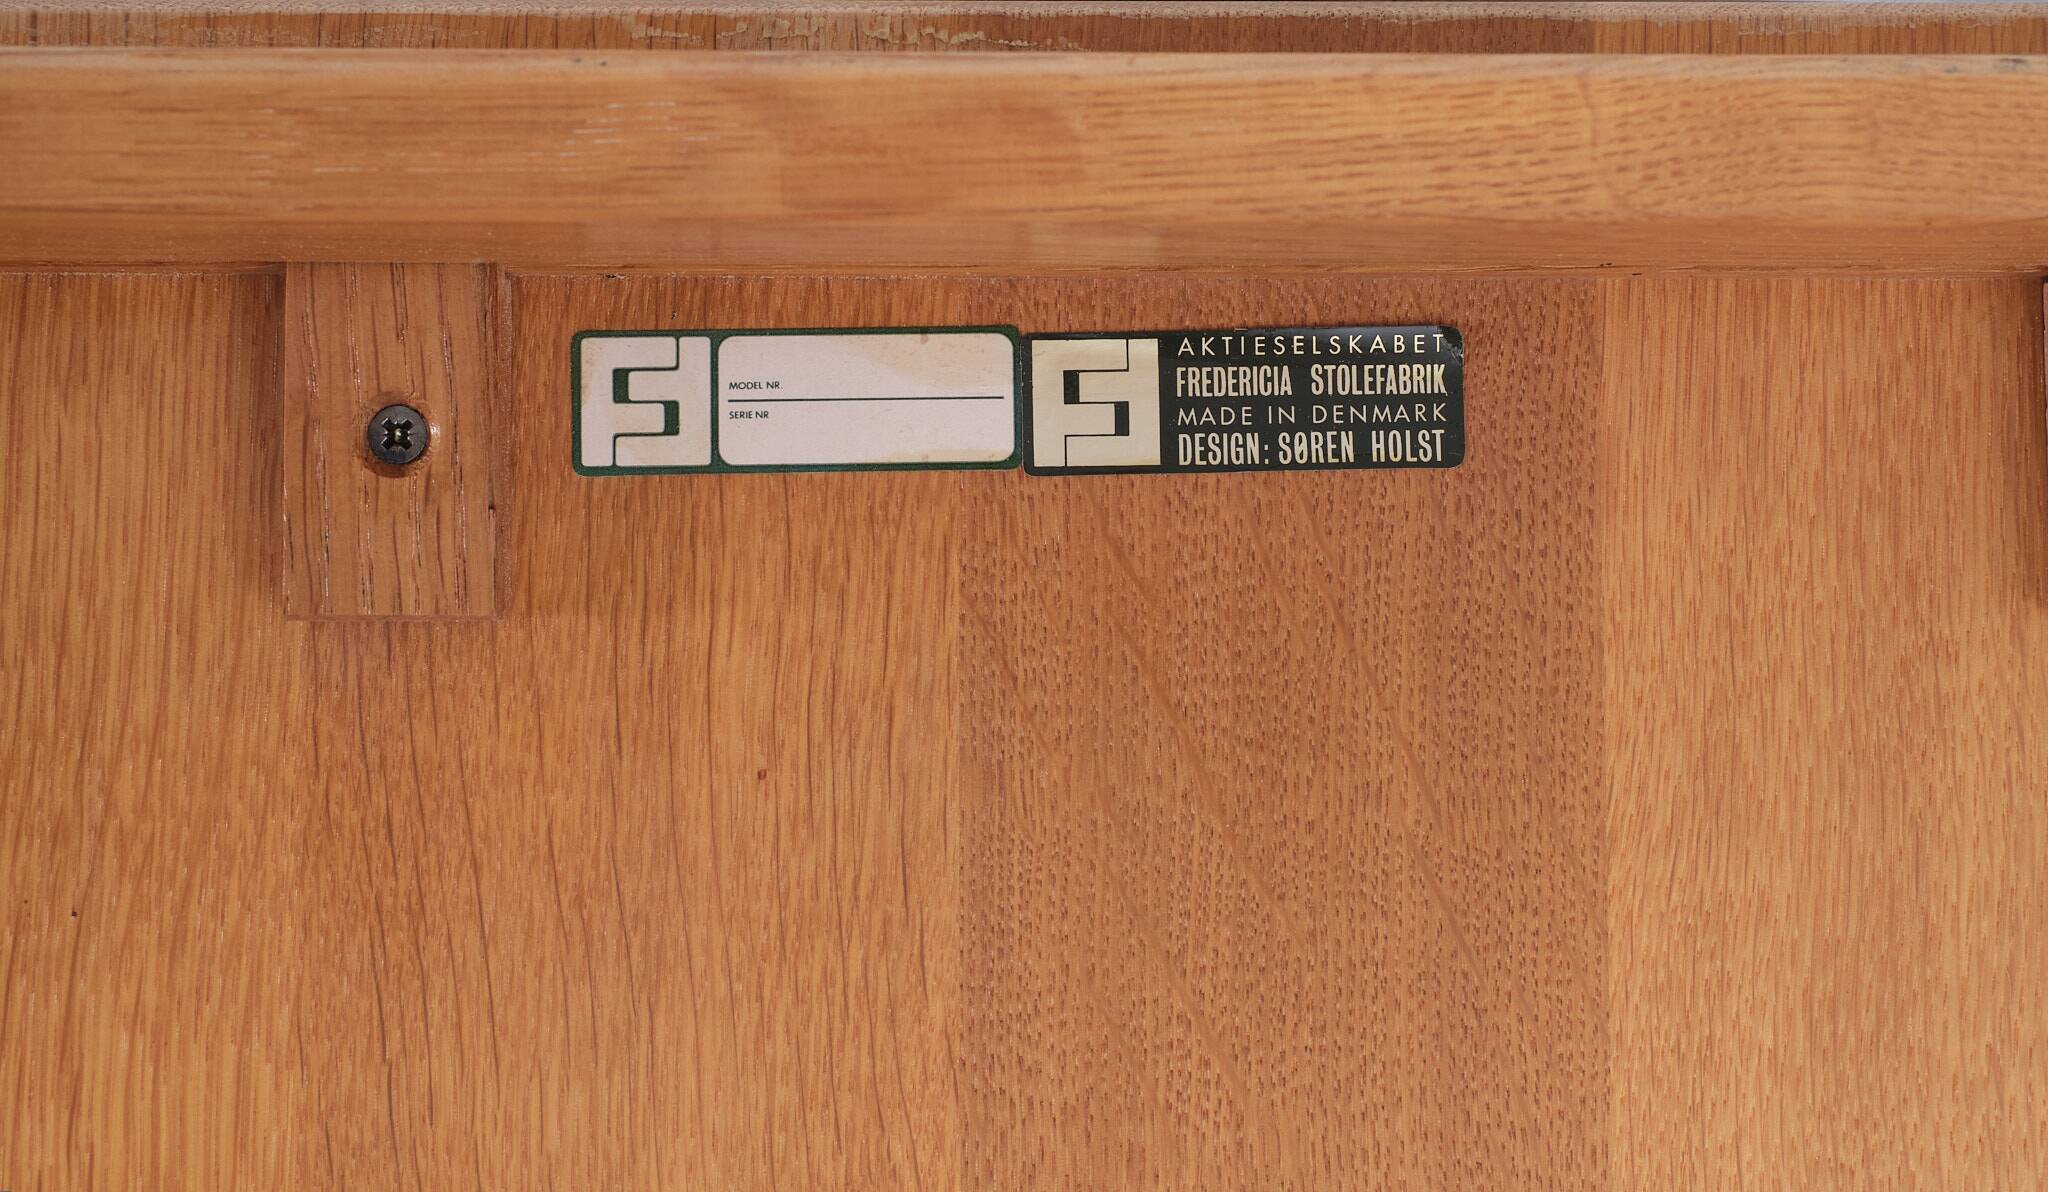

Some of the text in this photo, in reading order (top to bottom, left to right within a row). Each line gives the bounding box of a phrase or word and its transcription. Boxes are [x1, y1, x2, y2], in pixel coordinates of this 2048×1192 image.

[1178, 333, 1444, 356] AKTIESELSKABET
[728, 381, 763, 390] MODEL
[1176, 363, 1447, 398] FREDERICIA STOLEFABRIK
[728, 410, 769, 420] SERIE NR
[1177, 402, 1447, 426] MADE IN DENMARK
[1178, 429, 1445, 466] DESIGN: SØREN HOLST
